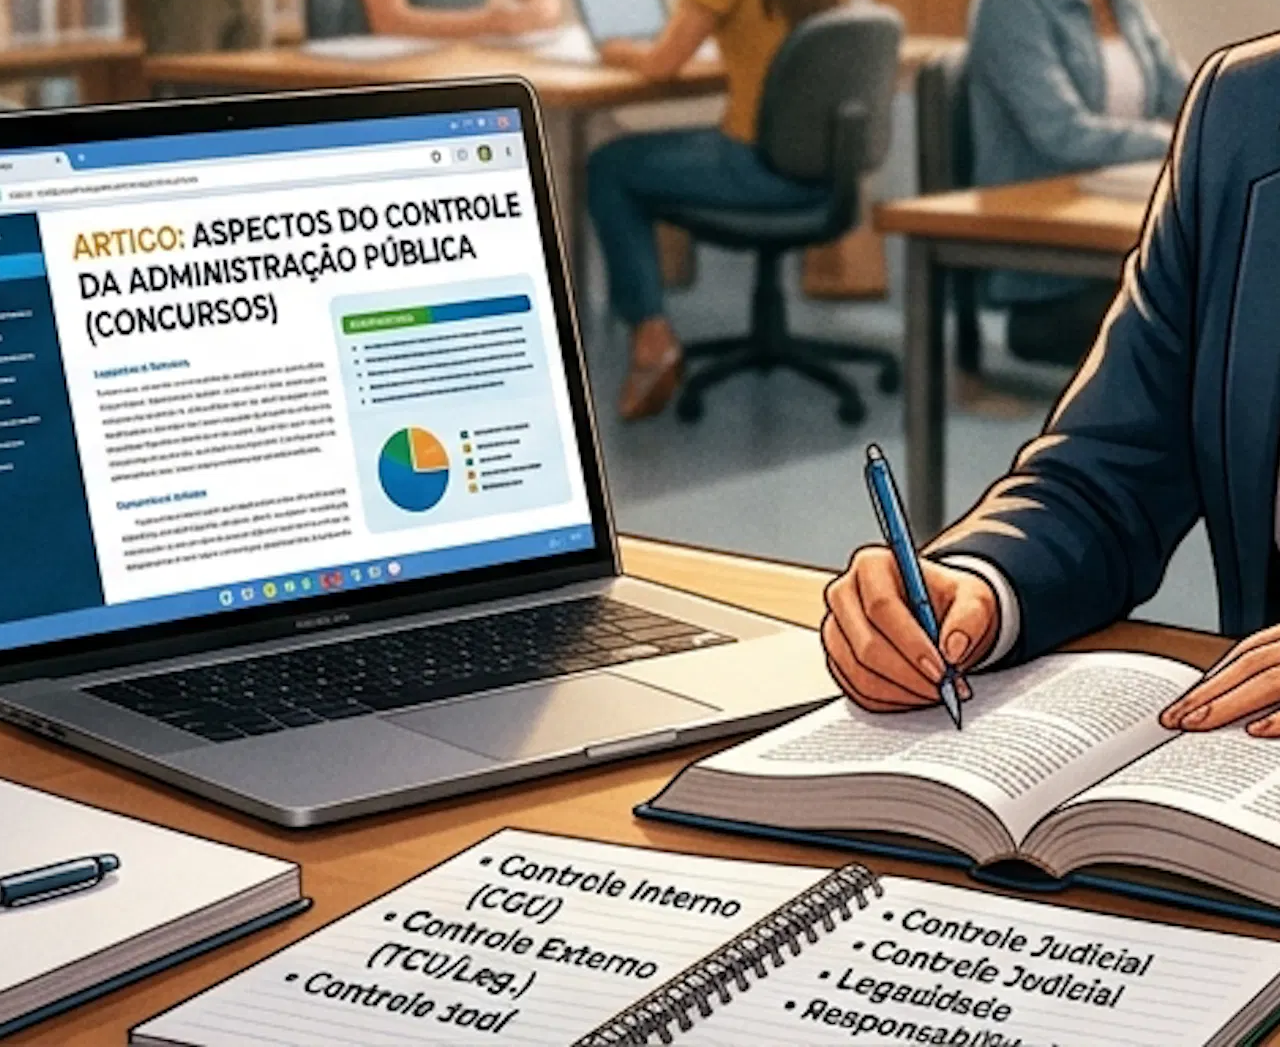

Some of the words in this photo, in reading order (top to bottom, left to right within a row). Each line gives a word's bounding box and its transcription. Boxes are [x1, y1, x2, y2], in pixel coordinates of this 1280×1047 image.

[72, 225, 186, 260] ARTICO:
[192, 209, 332, 249] ASPECTOS
[338, 204, 378, 232] DO
[385, 191, 522, 227] CONTROLE
[79, 269, 122, 300] DA
[128, 238, 358, 293] ADMINISTRAÇÃO
[363, 233, 477, 269] PÚBLICA
[86, 294, 279, 347] (CONCURSOS)
[499, 855, 626, 899] Controle
[630, 878, 742, 920] Interno
[403, 910, 533, 955] Controle
[536, 937, 658, 980] Externo
[901, 909, 1028, 953] Controle
